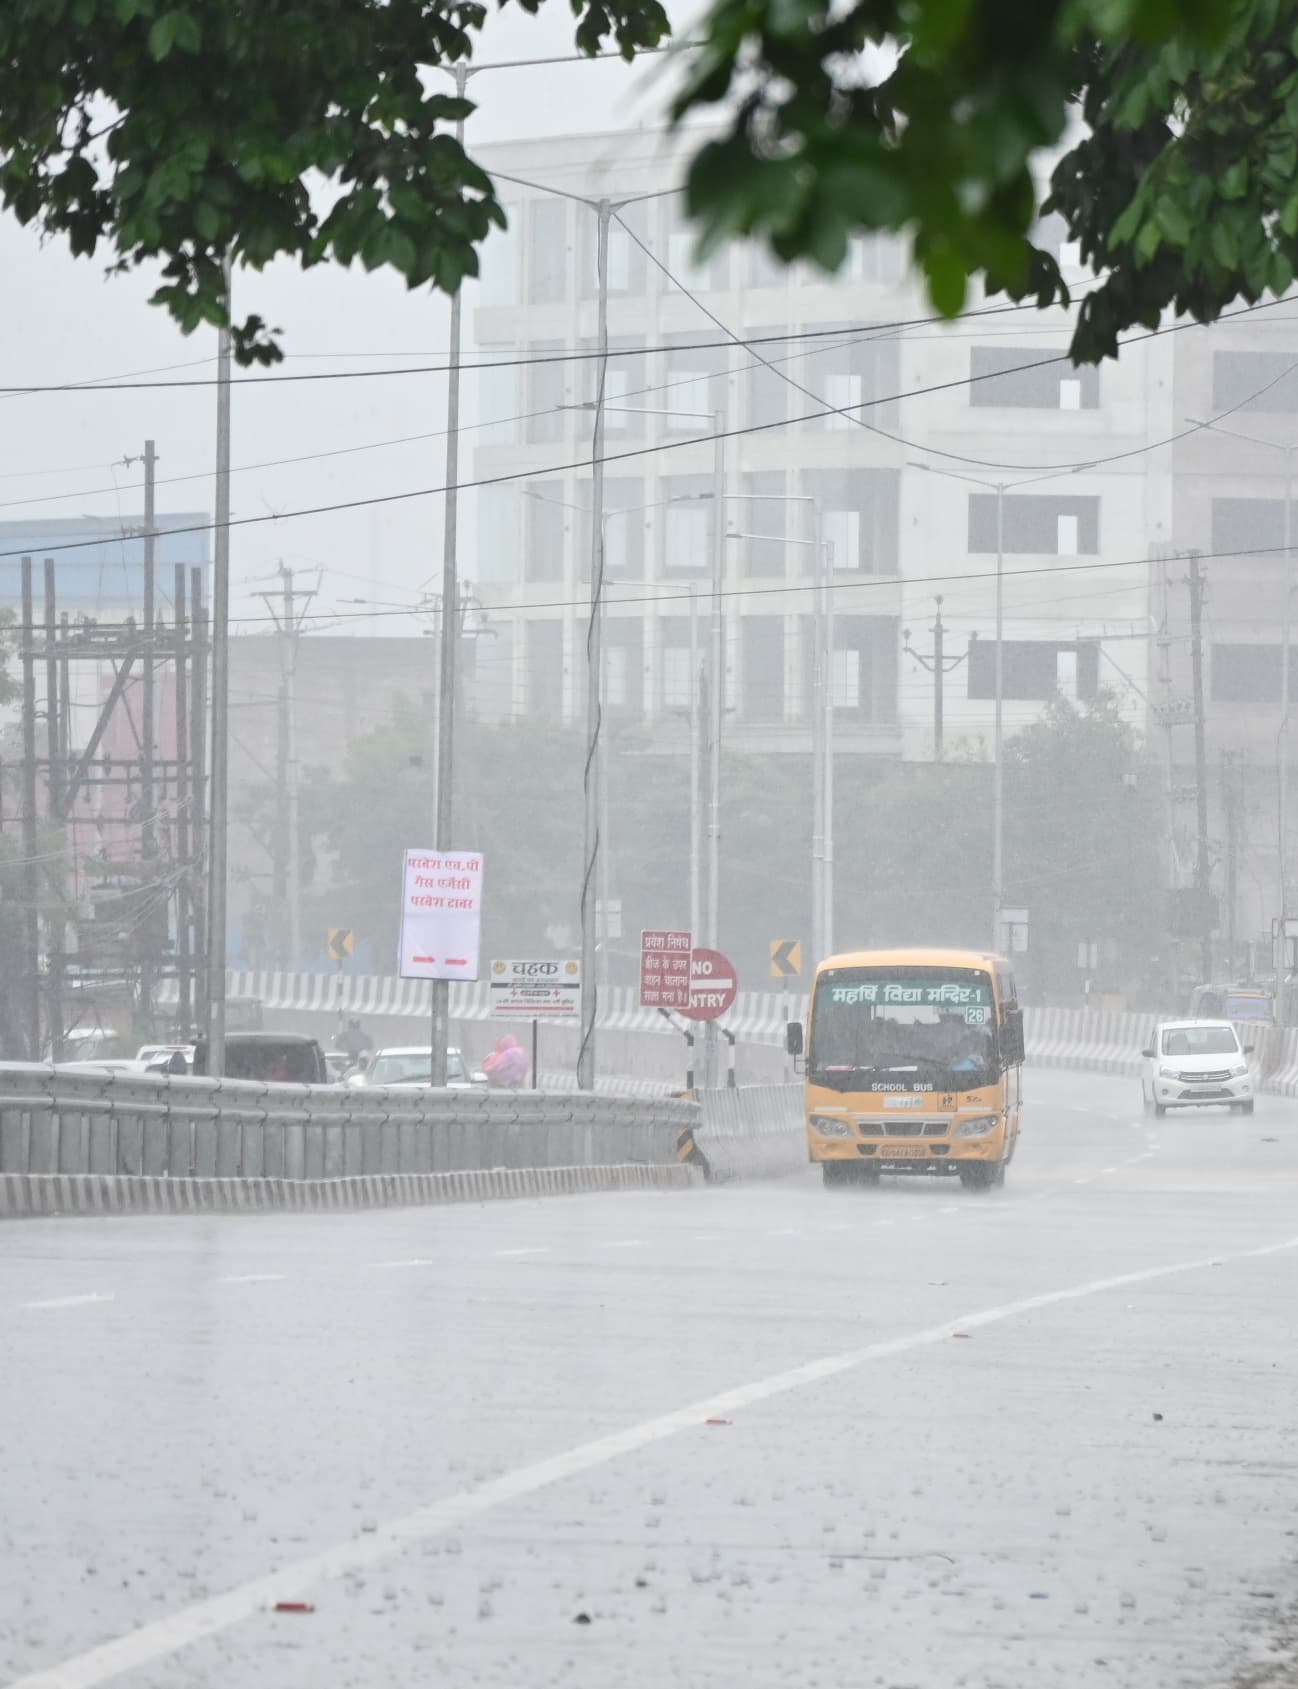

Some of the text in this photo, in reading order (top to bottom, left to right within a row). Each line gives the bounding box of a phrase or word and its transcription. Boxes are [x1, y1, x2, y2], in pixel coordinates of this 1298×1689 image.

[415, 874, 434, 888] गैस
[447, 897, 473, 909] टावर
[644, 933, 665, 949] प्रवेश
[511, 961, 560, 977] चहक
[691, 961, 713, 975] NO
[689, 993, 726, 1008] NTRY
[832, 984, 878, 1005] महर्षि
[883, 984, 923, 1002] विद्या
[968, 1009, 984, 1023] 26
[871, 1083, 934, 1092] SCHOOL BUS
